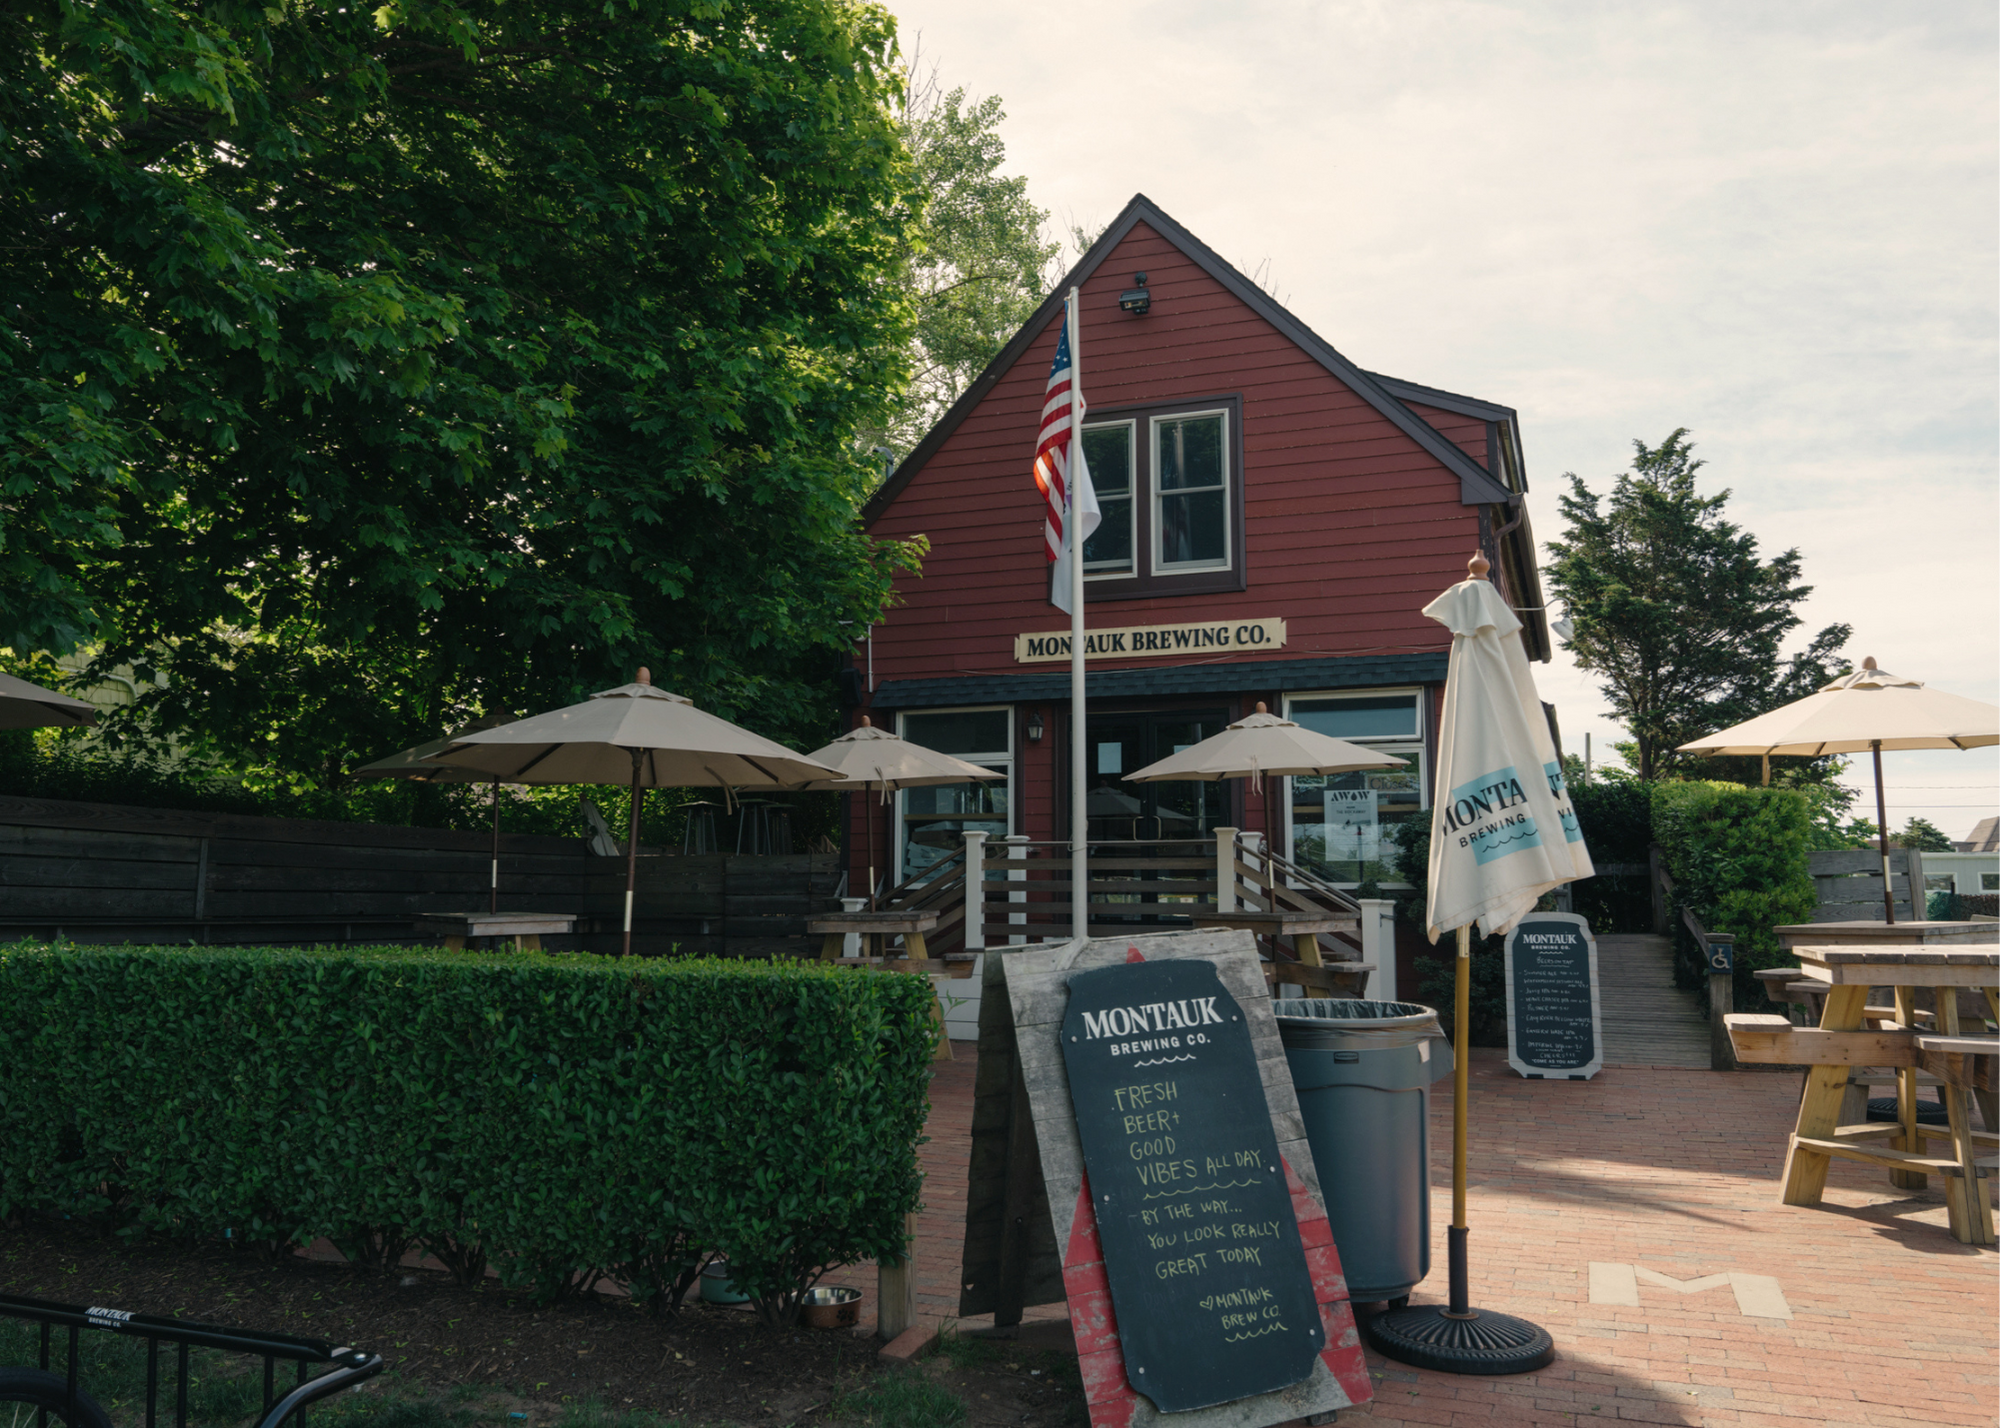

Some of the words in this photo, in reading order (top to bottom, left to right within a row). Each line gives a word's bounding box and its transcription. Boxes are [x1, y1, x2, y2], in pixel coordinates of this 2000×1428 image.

[1027, 633, 1126, 656] MONAUK
[1132, 627, 1230, 651] BREWING
[1236, 625, 1271, 645] CO.
[1459, 813, 1526, 848] BREWING
[1523, 934, 1577, 944] MONTAUK
[1081, 997, 1224, 1040] MONTAUK
[1110, 1036, 1180, 1056] BREWING
[1186, 1033, 1211, 1046] CO.
[1114, 1081, 1178, 1112] FRESH
[1129, 1136, 1176, 1161] GOOD
[1136, 1159, 1198, 1186] VIBES
[1206, 1154, 1231, 1177] ALL
[1141, 1207, 1160, 1226] BY
[1164, 1203, 1194, 1220] THE
[1200, 1199, 1242, 1215] WAY...
[1147, 1232, 1177, 1250] YOU
[1184, 1224, 1226, 1243] LOOK
[1231, 1221, 1280, 1239] REALLY
[1155, 1253, 1208, 1280] GREAT
[1216, 1246, 1262, 1267] TODAY
[1215, 1287, 1273, 1309] MONTAUK
[84, 1306, 136, 1321] MONTAUK
[88, 1317, 112, 1326] BREWING
[1221, 1311, 1257, 1330] BREW
